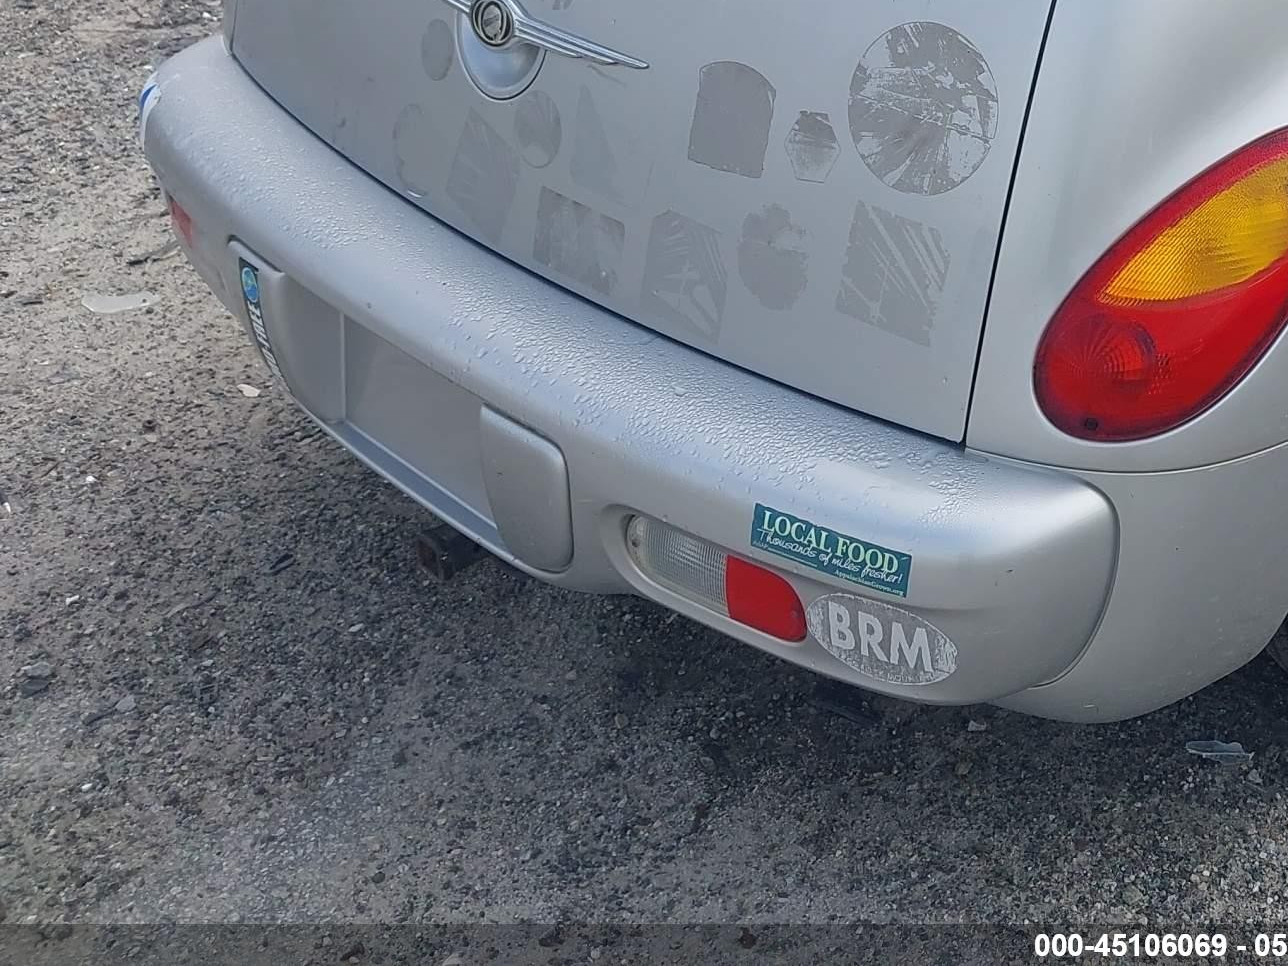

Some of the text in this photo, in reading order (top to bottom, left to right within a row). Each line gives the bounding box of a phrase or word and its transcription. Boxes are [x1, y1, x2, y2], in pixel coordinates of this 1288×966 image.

[757, 528, 818, 558] Thousands
[819, 551, 833, 566] of
[832, 558, 861, 573] miles
[861, 564, 903, 584] fresher!
[763, 510, 899, 574] LOCAL FOOD
[828, 600, 935, 673] BRM
